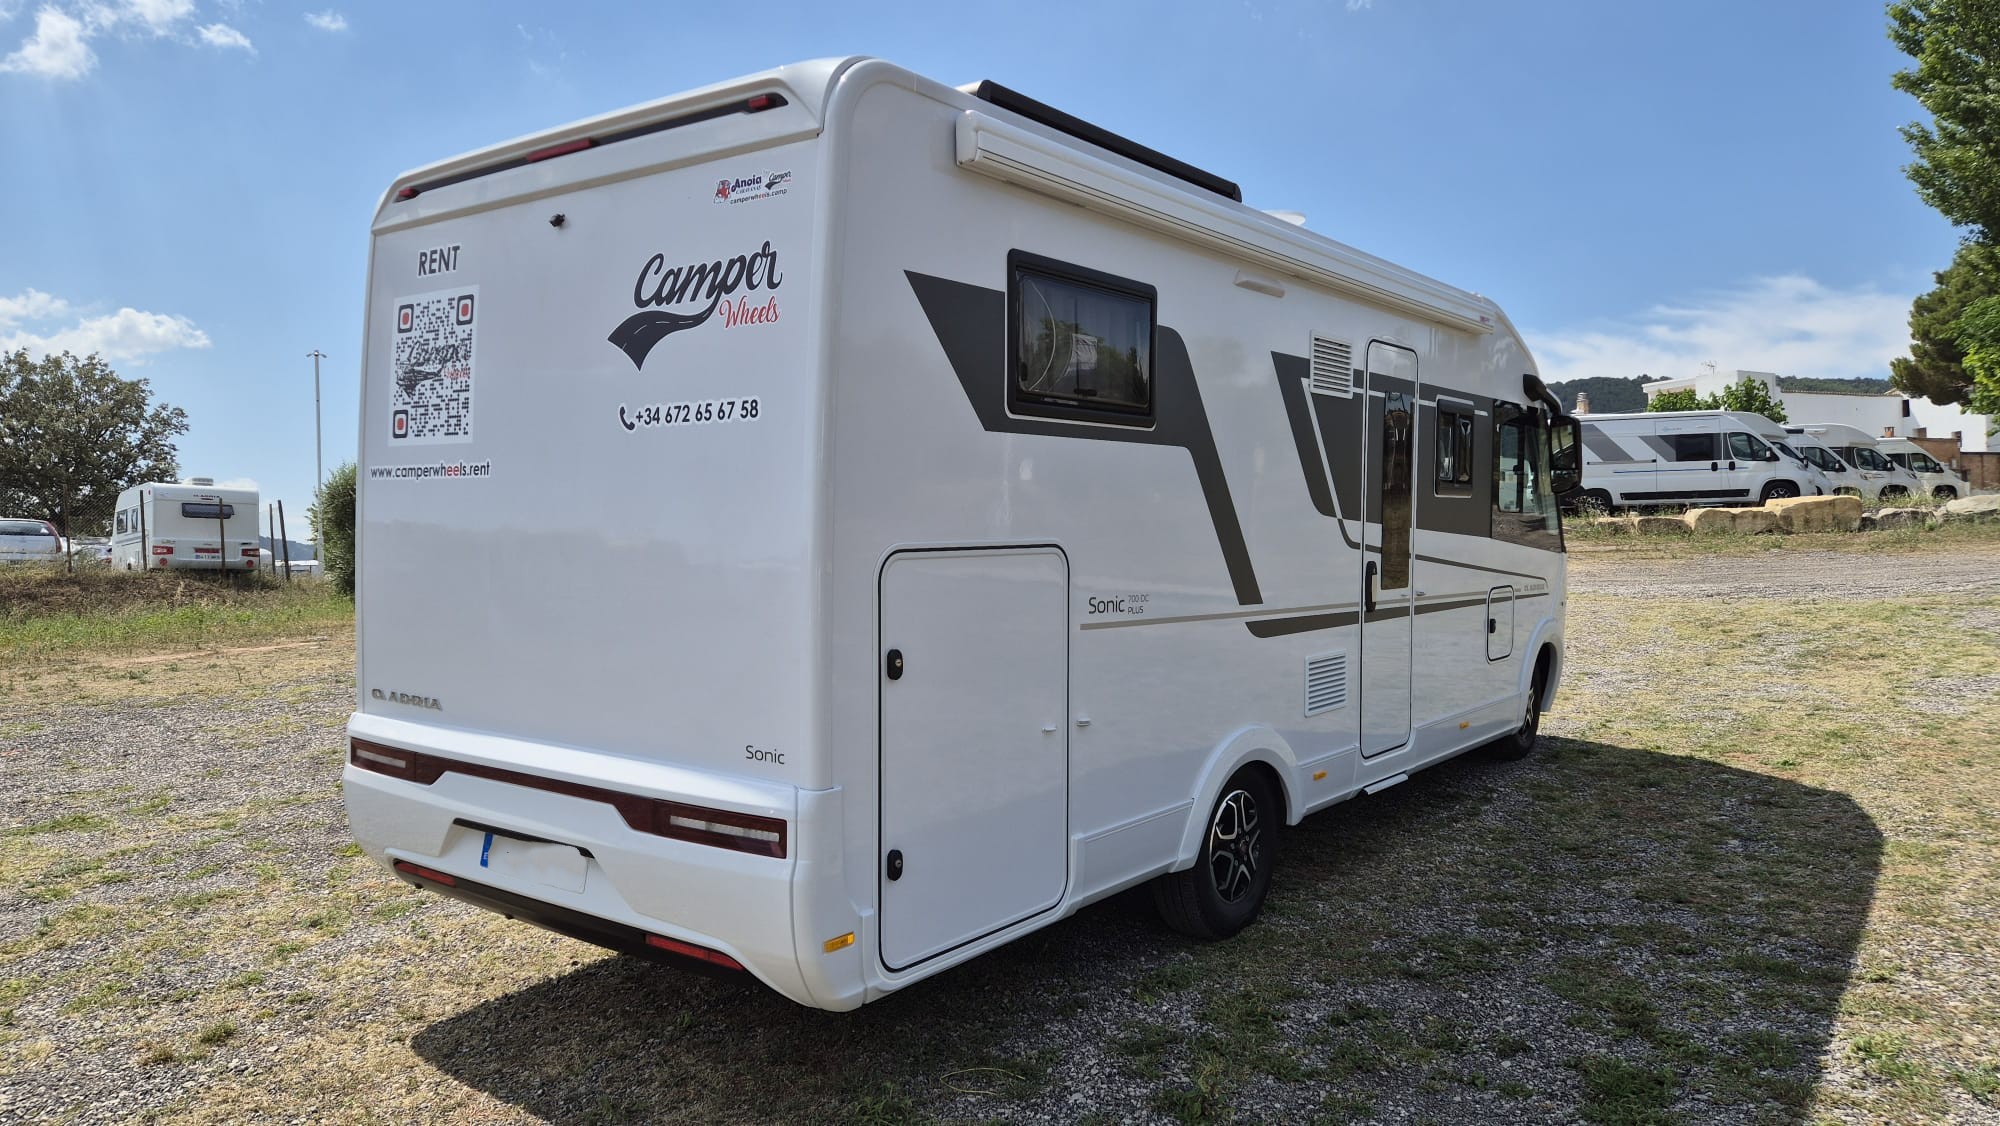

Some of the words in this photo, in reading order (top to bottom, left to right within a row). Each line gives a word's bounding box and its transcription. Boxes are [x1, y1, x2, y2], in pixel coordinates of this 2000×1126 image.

[731, 174, 762, 192] Anoia
[418, 246, 460, 276] RENT
[634, 240, 783, 308] Camper
[719, 295, 780, 328] Wheels
[635, 406, 660, 425] +34
[665, 404, 690, 423] 672
[695, 402, 712, 421] 65
[717, 401, 735, 420] 67
[740, 399, 758, 418] 58
[371, 460, 490, 480] www.camperwheels.rent
[1088, 595, 1125, 614] Sonic
[1127, 606, 1144, 614] PLUS
[388, 691, 443, 711] ADRIA
[745, 744, 784, 764] Sonic
